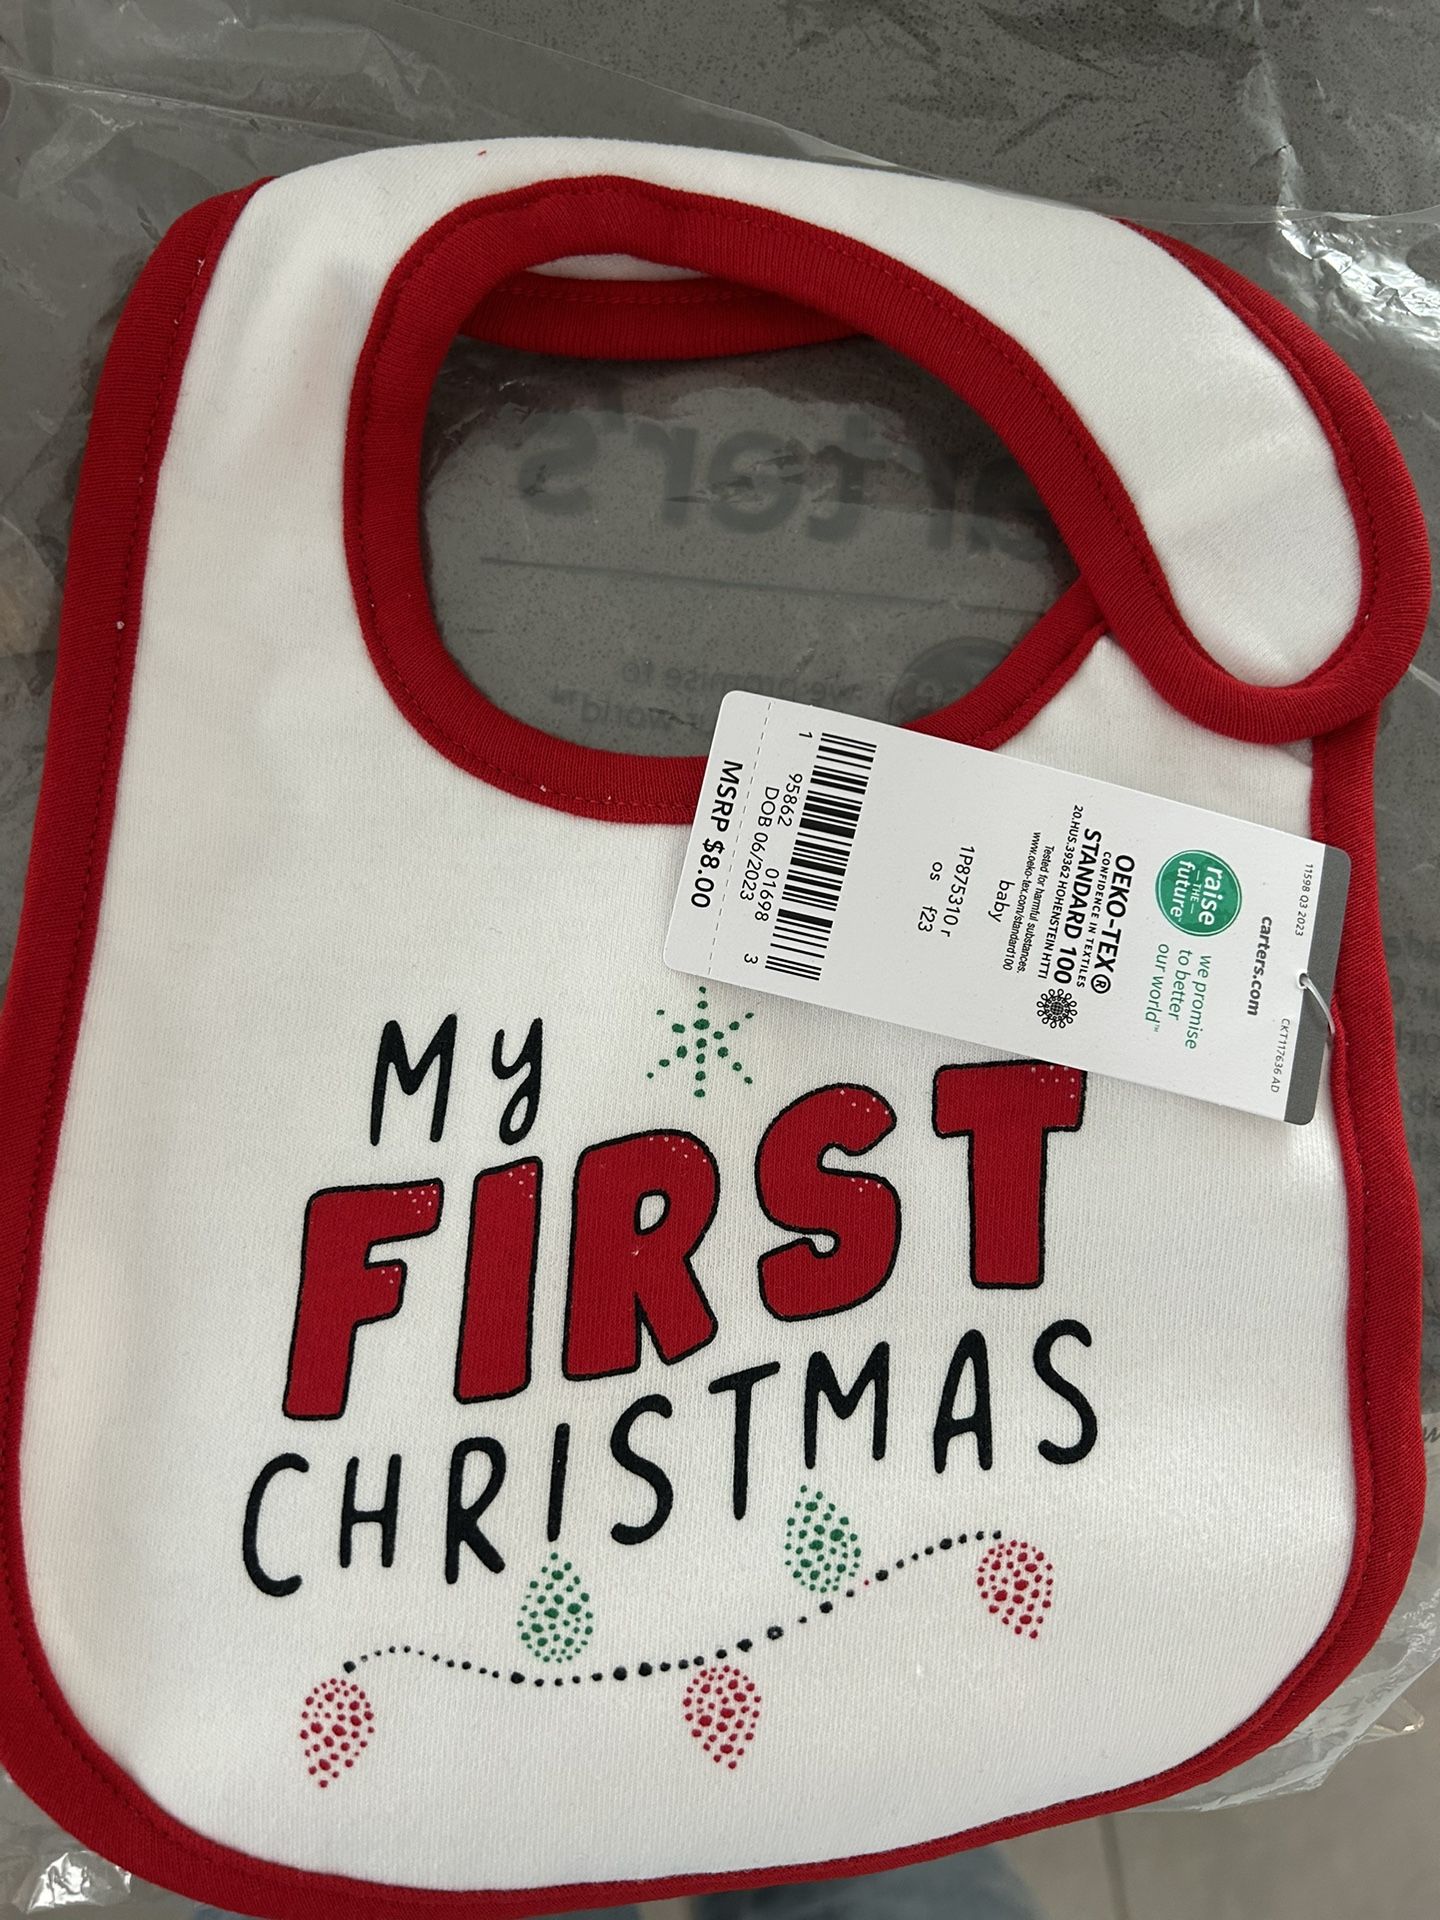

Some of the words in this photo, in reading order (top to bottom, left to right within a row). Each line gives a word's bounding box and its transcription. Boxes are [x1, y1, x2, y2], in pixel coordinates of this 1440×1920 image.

[798, 730, 813, 739] 1
[710, 759, 743, 833] MSRP
[757, 786, 780, 828] DOB
[777, 773, 803, 828] 95862
[1040, 845, 1055, 874] Tested
[1059, 805, 1084, 879] 20.HUS.39362
[690, 837, 726, 908] $8.00
[739, 831, 769, 901] 06/2023
[929, 861, 943, 881] os
[942, 844, 976, 926] 1P875310
[1037, 874, 1049, 888] for
[1064, 828, 1102, 939] STANDARD
[1090, 851, 1112, 919] CONFIDENCE
[1302, 863, 1314, 894] 11598
[754, 867, 780, 922] 01698
[988, 879, 1015, 922] baby
[1002, 831, 1041, 971] www.oeko-tex.com/standard100
[1029, 887, 1045, 921] harmful
[1044, 880, 1068, 951] HOHENSTEIN
[1190, 881, 1200, 905] THE
[1198, 866, 1223, 926] raise
[1299, 895, 1308, 910] Q3
[918, 905, 938, 932] f23
[941, 927, 952, 937] r
[1088, 923, 1098, 934] IN
[1295, 911, 1306, 936] 2023
[743, 953, 759, 964] 3
[1017, 922, 1036, 973] substances.
[1038, 952, 1051, 979] HTTI
[1053, 946, 1078, 985] 100
[1076, 938, 1094, 988] TEXTILES
[1155, 943, 1170, 974] our
[1178, 949, 1192, 965] to
[1196, 955, 1212, 979] we
[1247, 915, 1273, 1017] carters.com
[1168, 966, 1191, 1021] better
[1185, 979, 1209, 1050] promise
[1273, 1018, 1290, 1077] CKT117636
[370, 1013, 544, 1146] My
[1270, 1079, 1281, 1093] AD
[282, 1060, 1089, 1422] FIRST
[242, 1319, 1099, 1597] CHRISTMAS
